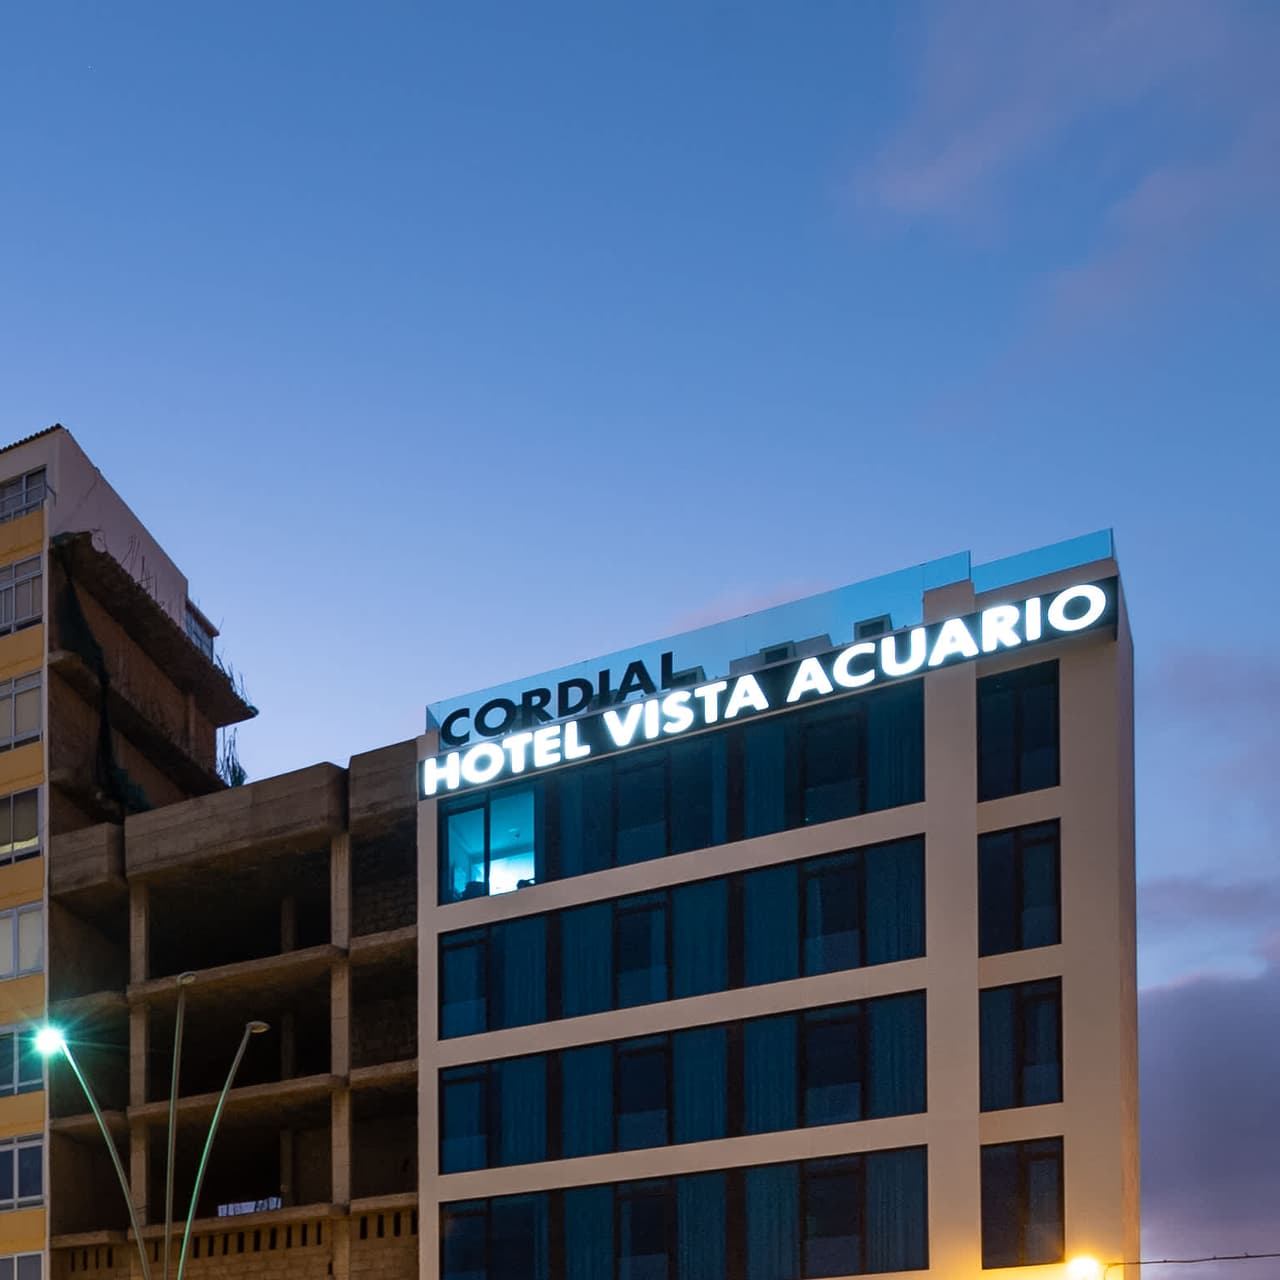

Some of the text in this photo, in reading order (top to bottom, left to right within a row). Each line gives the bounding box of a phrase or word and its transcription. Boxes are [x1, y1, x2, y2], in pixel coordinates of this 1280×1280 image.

[424, 584, 1107, 796] HOTEL VISTA ACUARIO
[440, 651, 680, 746] CORDIAL
